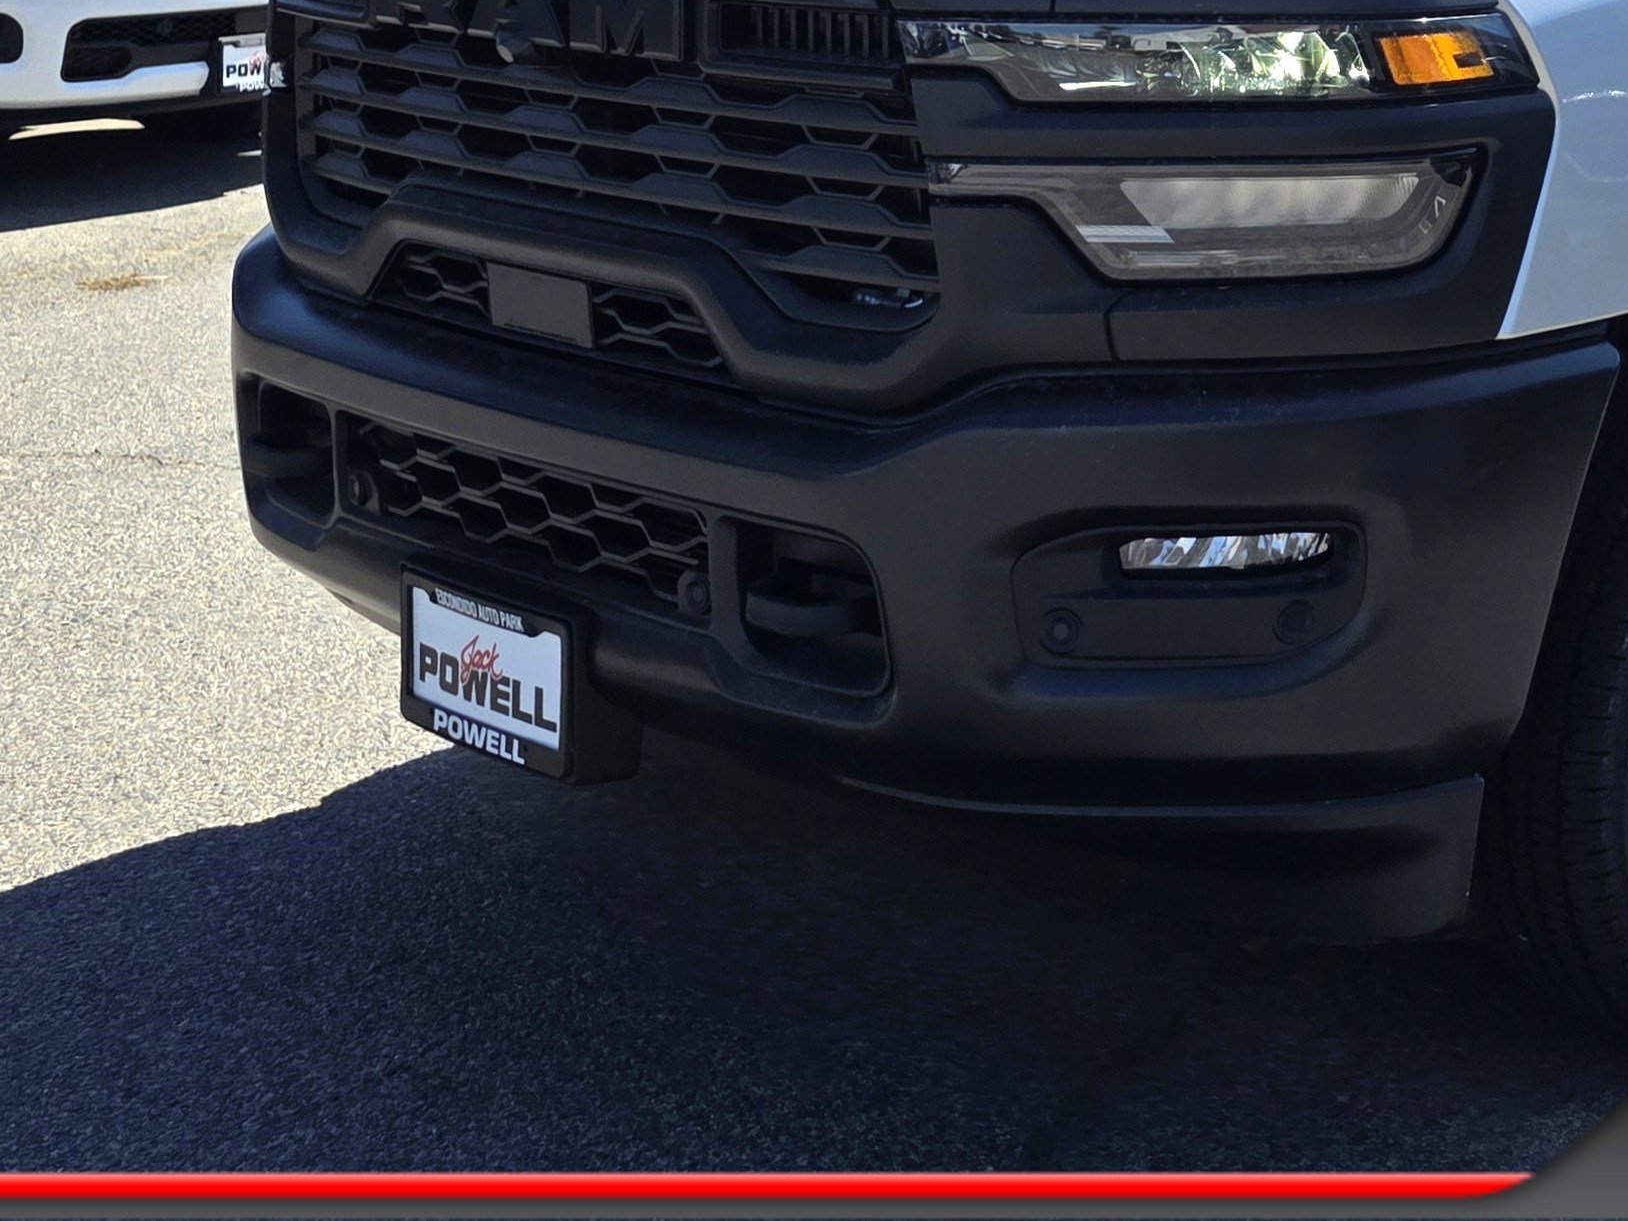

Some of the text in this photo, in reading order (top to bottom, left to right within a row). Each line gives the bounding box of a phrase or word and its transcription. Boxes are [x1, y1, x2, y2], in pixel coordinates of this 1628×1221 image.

[226, 63, 262, 79] POW
[460, 634, 504, 686] Jack
[419, 642, 558, 734] POWELL
[433, 708, 526, 765] POWELL
